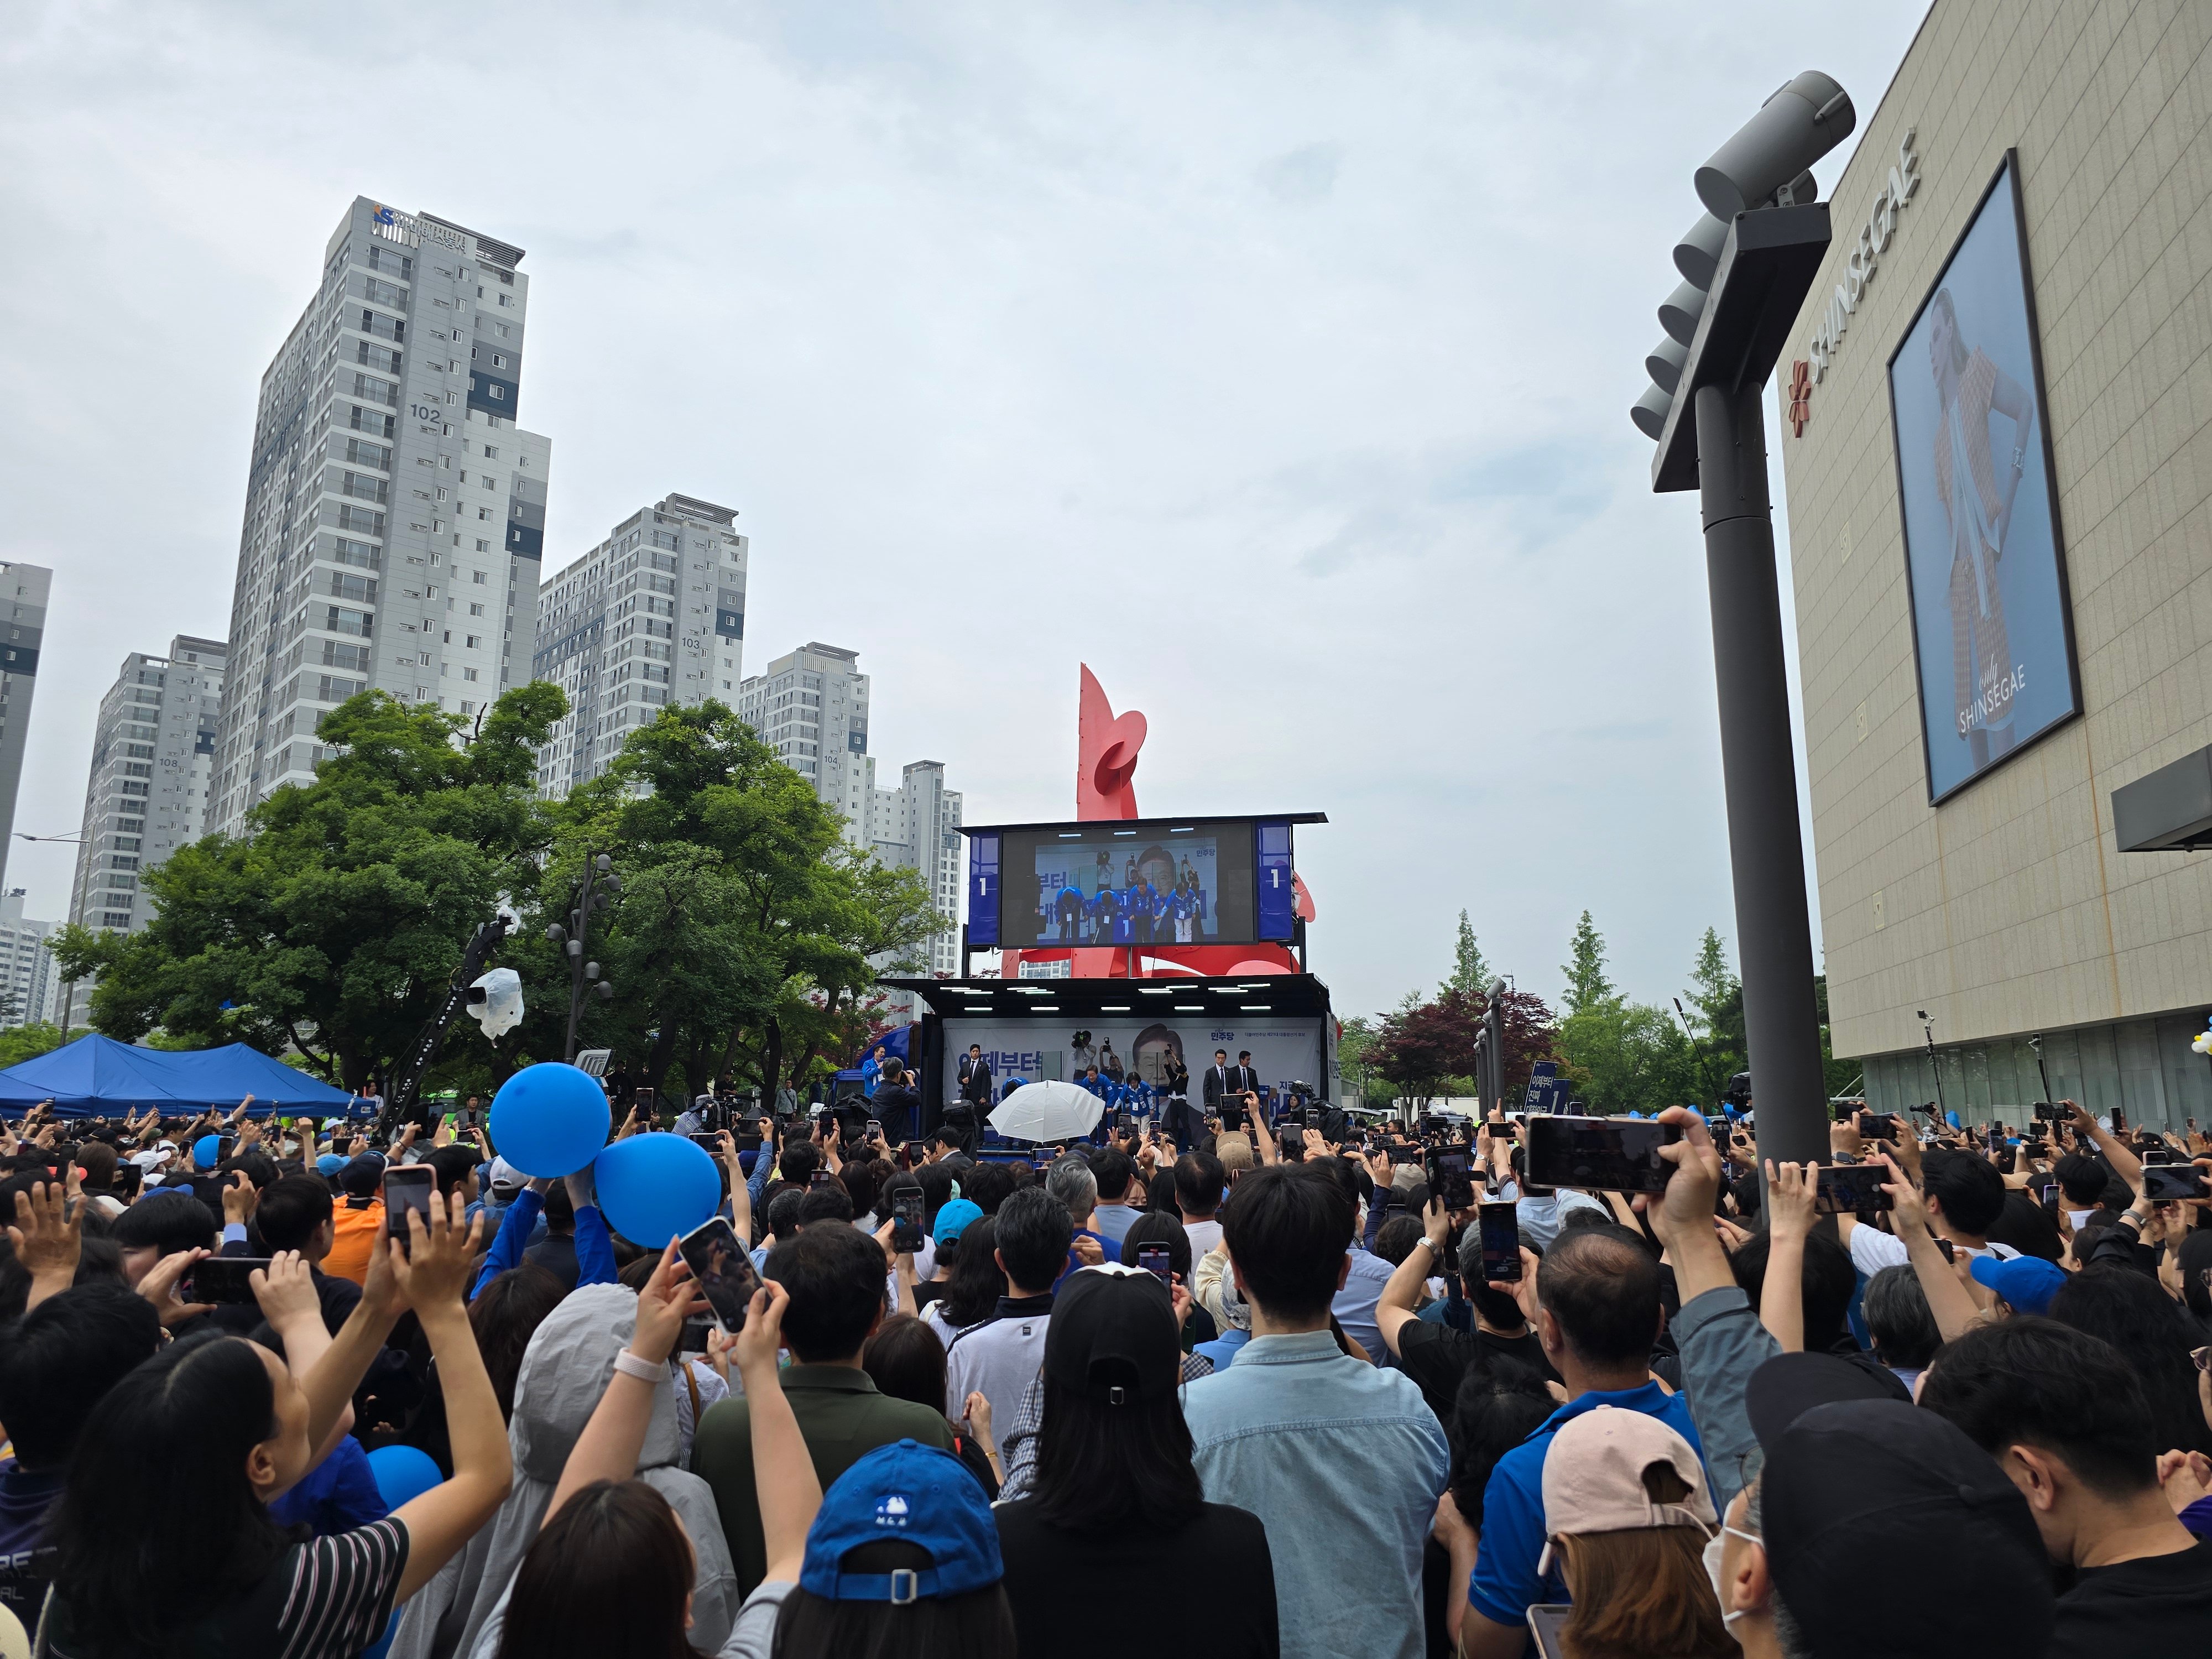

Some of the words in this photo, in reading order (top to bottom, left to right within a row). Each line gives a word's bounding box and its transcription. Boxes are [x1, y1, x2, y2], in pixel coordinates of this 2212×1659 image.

[1810, 127, 1921, 384] SHINSEGAE
[410, 404, 441, 424] 102
[682, 637, 700, 649] 103
[1959, 664, 2026, 733] SHINSEGAE
[159, 758, 178, 768] 108
[824, 755, 837, 764] 104
[1196, 849, 1215, 857] 민주당
[1271, 869, 1279, 888] 1
[979, 878, 986, 896] 1
[1211, 1032, 1235, 1041] 민주당
[1532, 1074, 1554, 1089] 이제부터
[1528, 1089, 1541, 1103] 진짜
